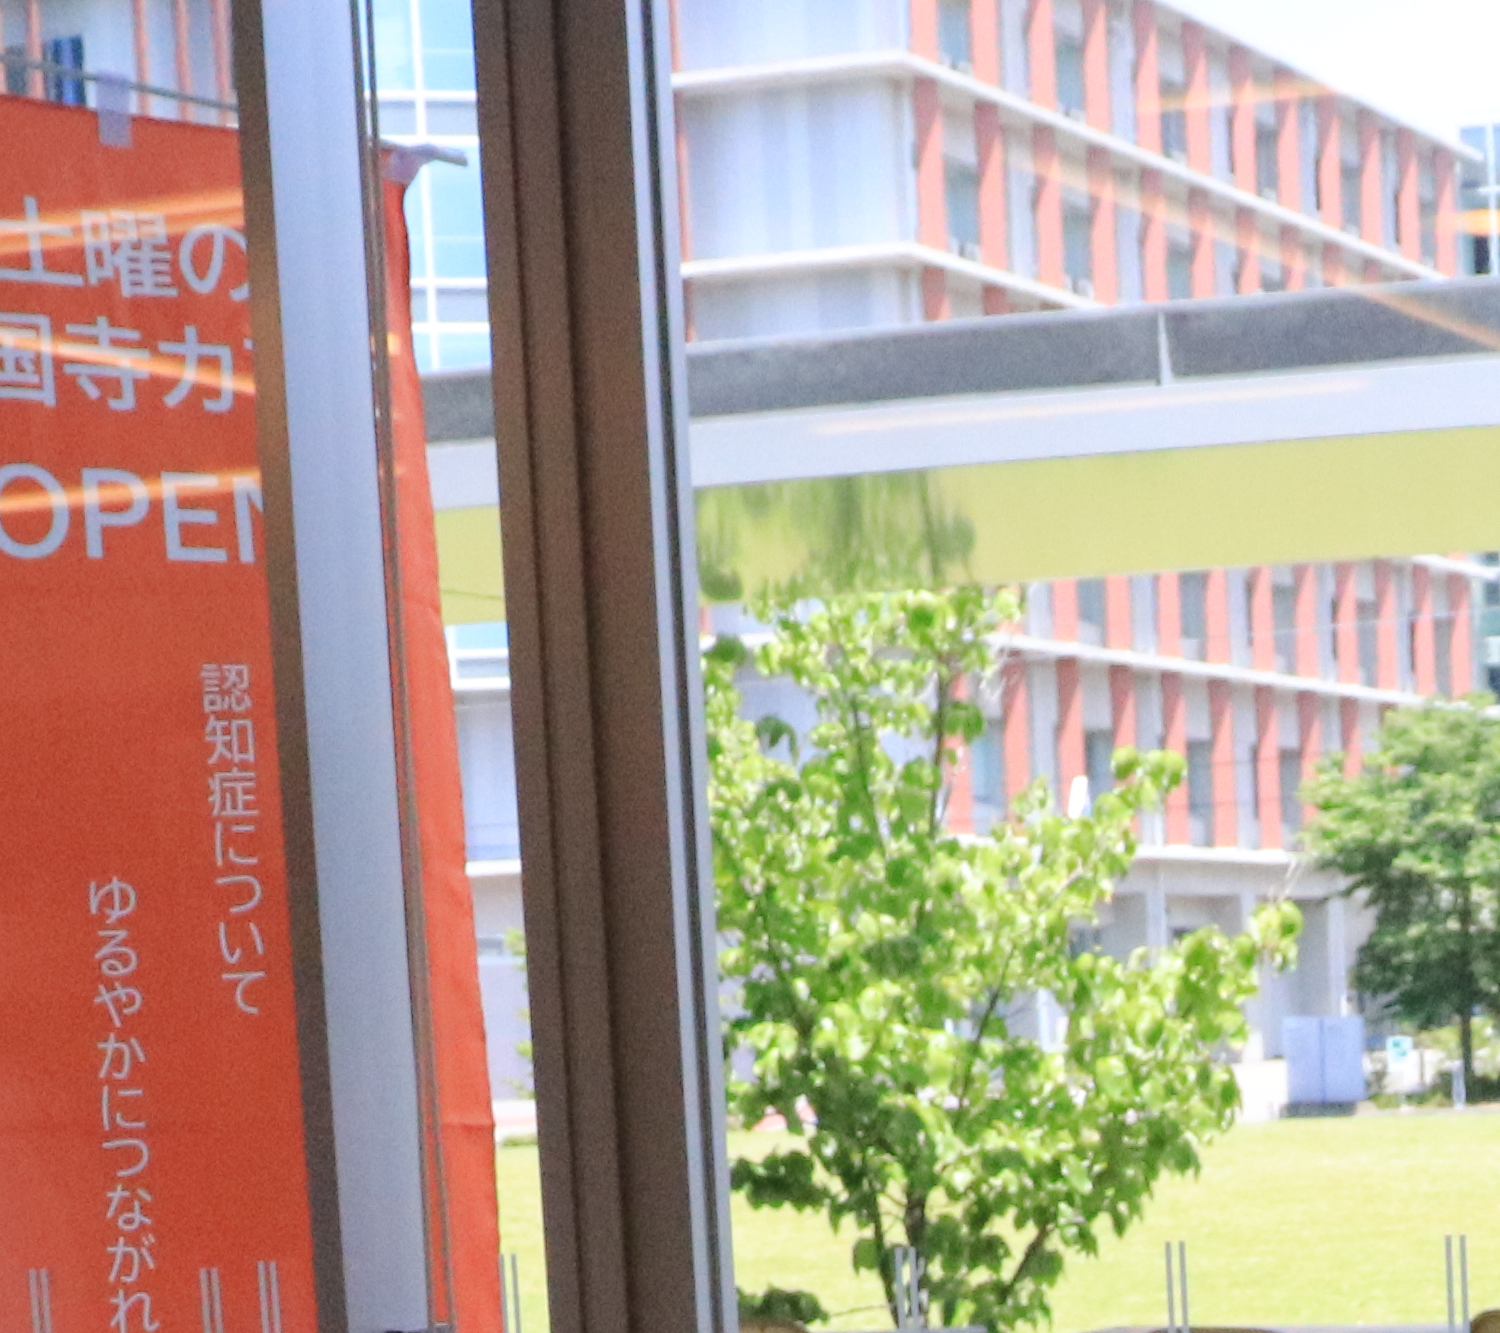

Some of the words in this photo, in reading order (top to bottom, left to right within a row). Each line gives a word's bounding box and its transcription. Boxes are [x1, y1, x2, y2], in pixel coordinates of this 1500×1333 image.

[200, 661, 268, 1017] 認知症について
